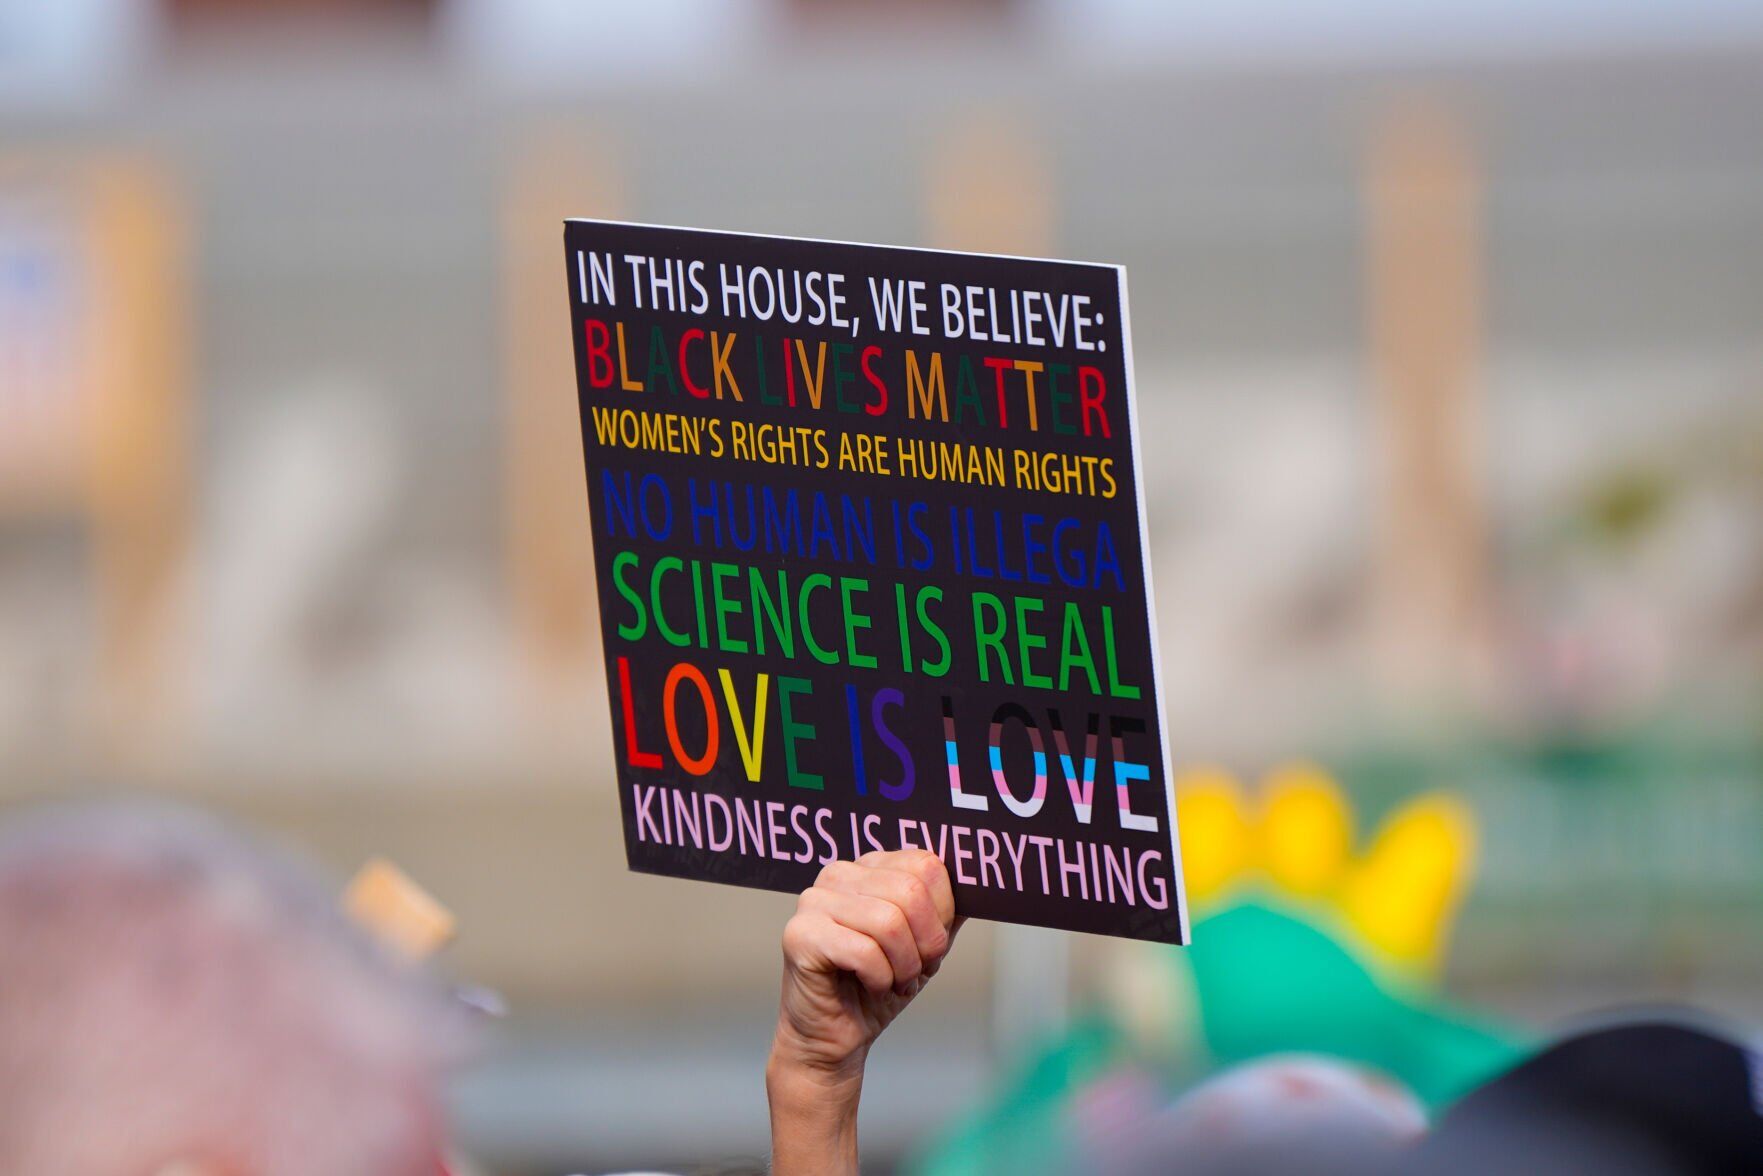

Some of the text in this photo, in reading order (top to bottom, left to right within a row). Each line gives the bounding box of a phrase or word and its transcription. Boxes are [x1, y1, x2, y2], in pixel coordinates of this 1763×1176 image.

[577, 250, 1106, 352] IN THIS HOUSE, WE BELIEVE:
[585, 319, 1112, 439] BLACK LIVES MATTER
[592, 406, 1117, 499] WOMEN'S RIGHTS ARE HUMAN RIGHTS
[602, 467, 1126, 592] NO HUMAN IS ILLEGA
[612, 551, 1141, 699] SCIENCE IS REAL
[617, 656, 1159, 833] LOVE IS LOVE
[633, 783, 838, 865] KINDNESS
[850, 812, 884, 861] IS
